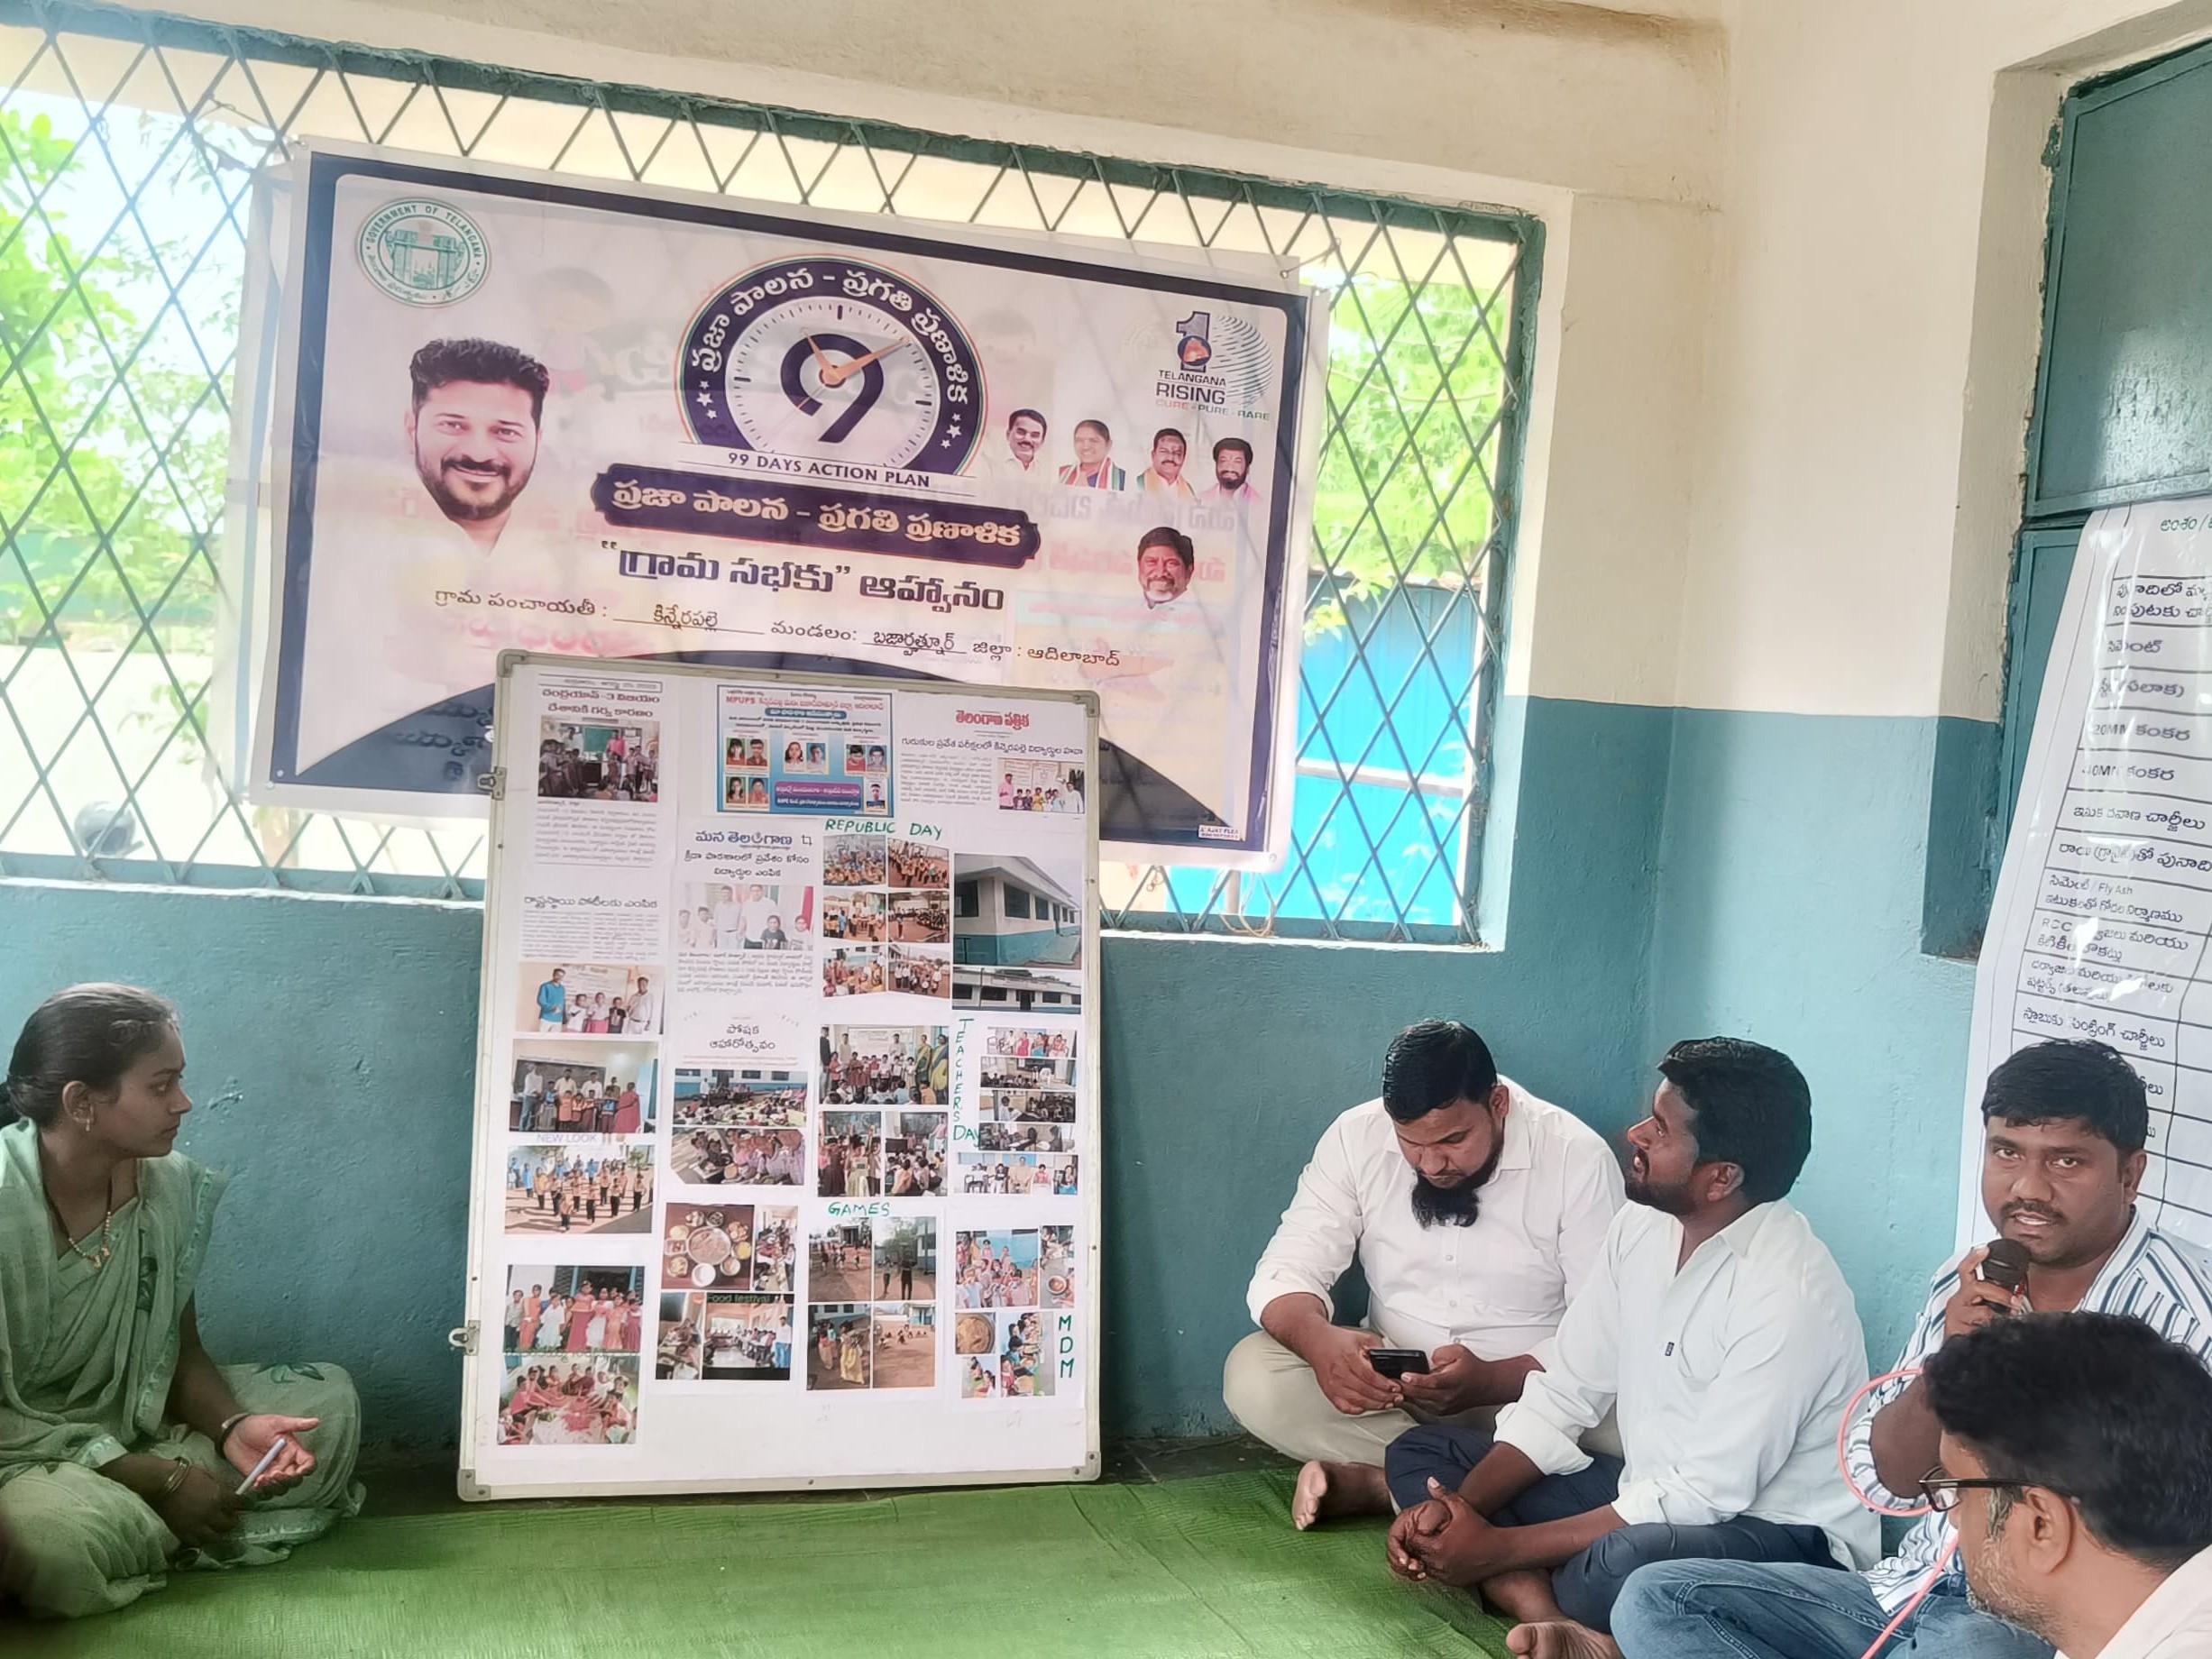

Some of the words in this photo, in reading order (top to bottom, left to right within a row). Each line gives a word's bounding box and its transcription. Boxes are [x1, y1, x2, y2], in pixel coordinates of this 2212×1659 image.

[366, 205, 417, 243] GOVERNMENT
[425, 206, 437, 215] OF
[445, 213, 482, 258] TELANGANA
[692, 315, 730, 372] ప్రజా
[730, 268, 813, 316] పాలన
[842, 269, 913, 312] ప్రగతి
[911, 308, 968, 405] ప్రణాళిక
[1159, 370, 1226, 387] TELANGANA
[1156, 381, 1225, 405] RISING
[1155, 399, 1189, 410] CURE
[1198, 404, 1229, 416] PURE
[1238, 409, 1271, 421] RARE
[729, 452, 748, 465] 99
[757, 455, 801, 472] DAYS
[808, 463, 877, 481] ACTION
[886, 471, 930, 488] PLAN
[612, 479, 686, 510] ప్రజా
[693, 488, 788, 521] పాలన
[817, 501, 900, 534] ప్రగతి
[904, 513, 1022, 548] ప్రణాళిక
[859, 574, 1005, 614] ఆహ్వానం
[435, 590, 482, 607] గ్రామ
[488, 593, 595, 617] పంచాయతీ
[771, 621, 857, 641] మండలం:
[973, 641, 1012, 661] జిల్లా
[1027, 646, 1121, 667] ఆదిలాబాద్
[2135, 724, 2190, 741] కంకర
[695, 830, 725, 843] మన
[825, 819, 896, 833] REPUBLIC
[909, 822, 943, 840] DAY
[2098, 883, 2113, 894] Fly
[537, 1133, 565, 1144] NEW
[566, 1133, 598, 1144] LOOK
[828, 1201, 890, 1216] GAMES
